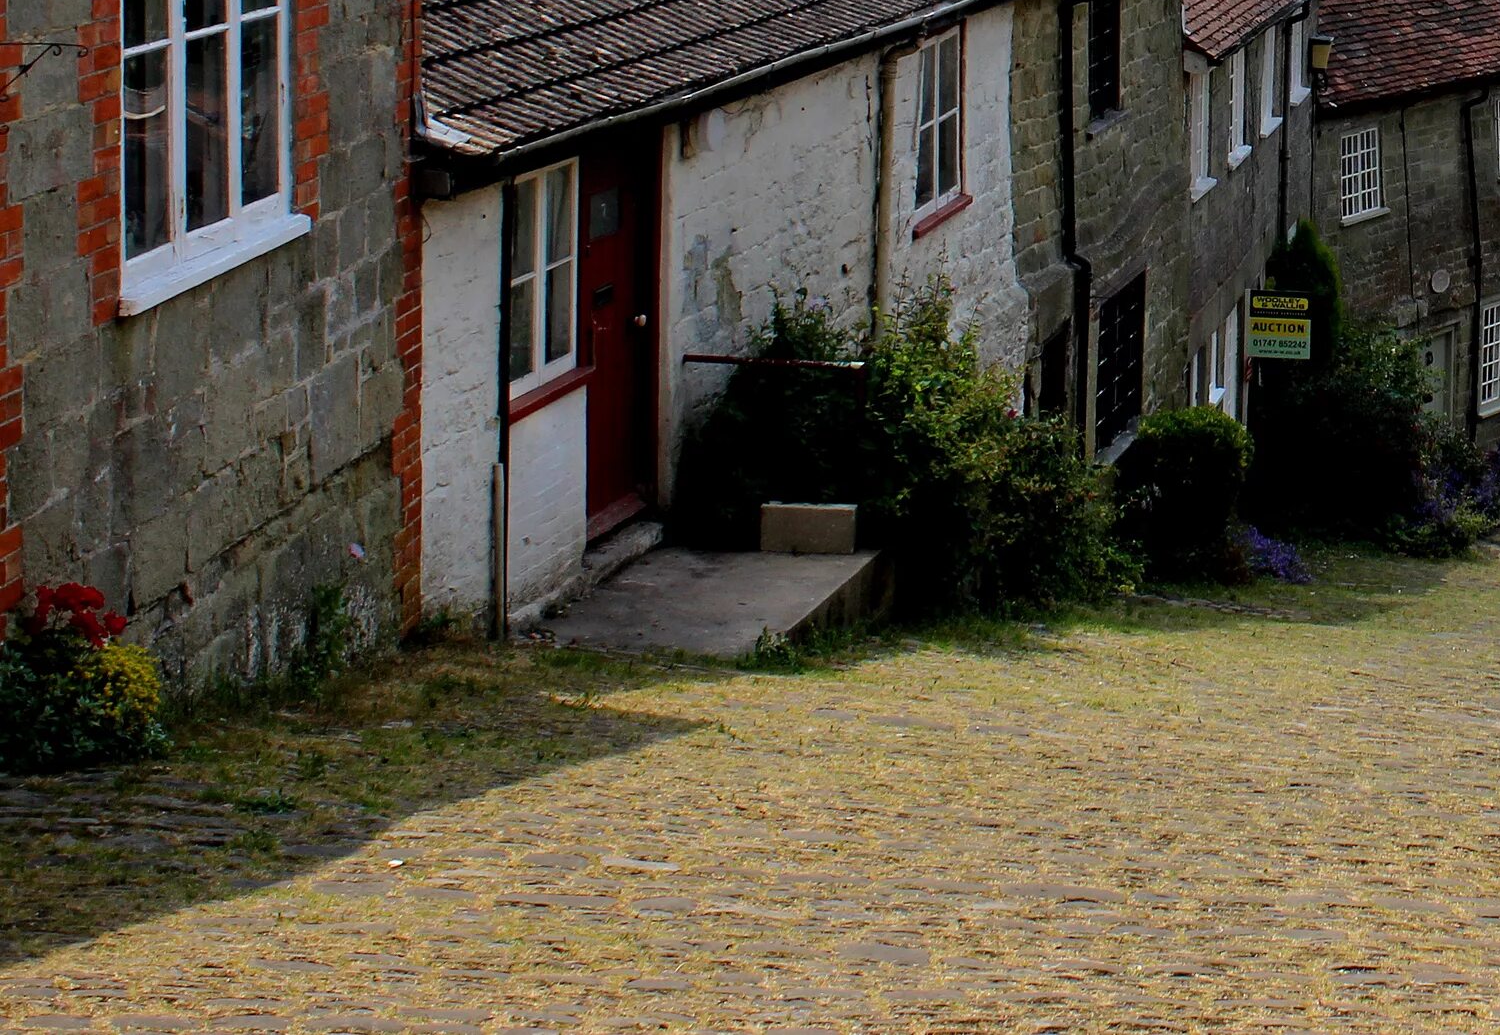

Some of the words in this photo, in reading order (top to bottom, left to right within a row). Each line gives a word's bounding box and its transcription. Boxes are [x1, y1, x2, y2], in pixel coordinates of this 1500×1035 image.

[1256, 296, 1301, 304] WOOLLEY
[1252, 322, 1305, 333] AUCTION
[1252, 339, 1277, 347] 01747
